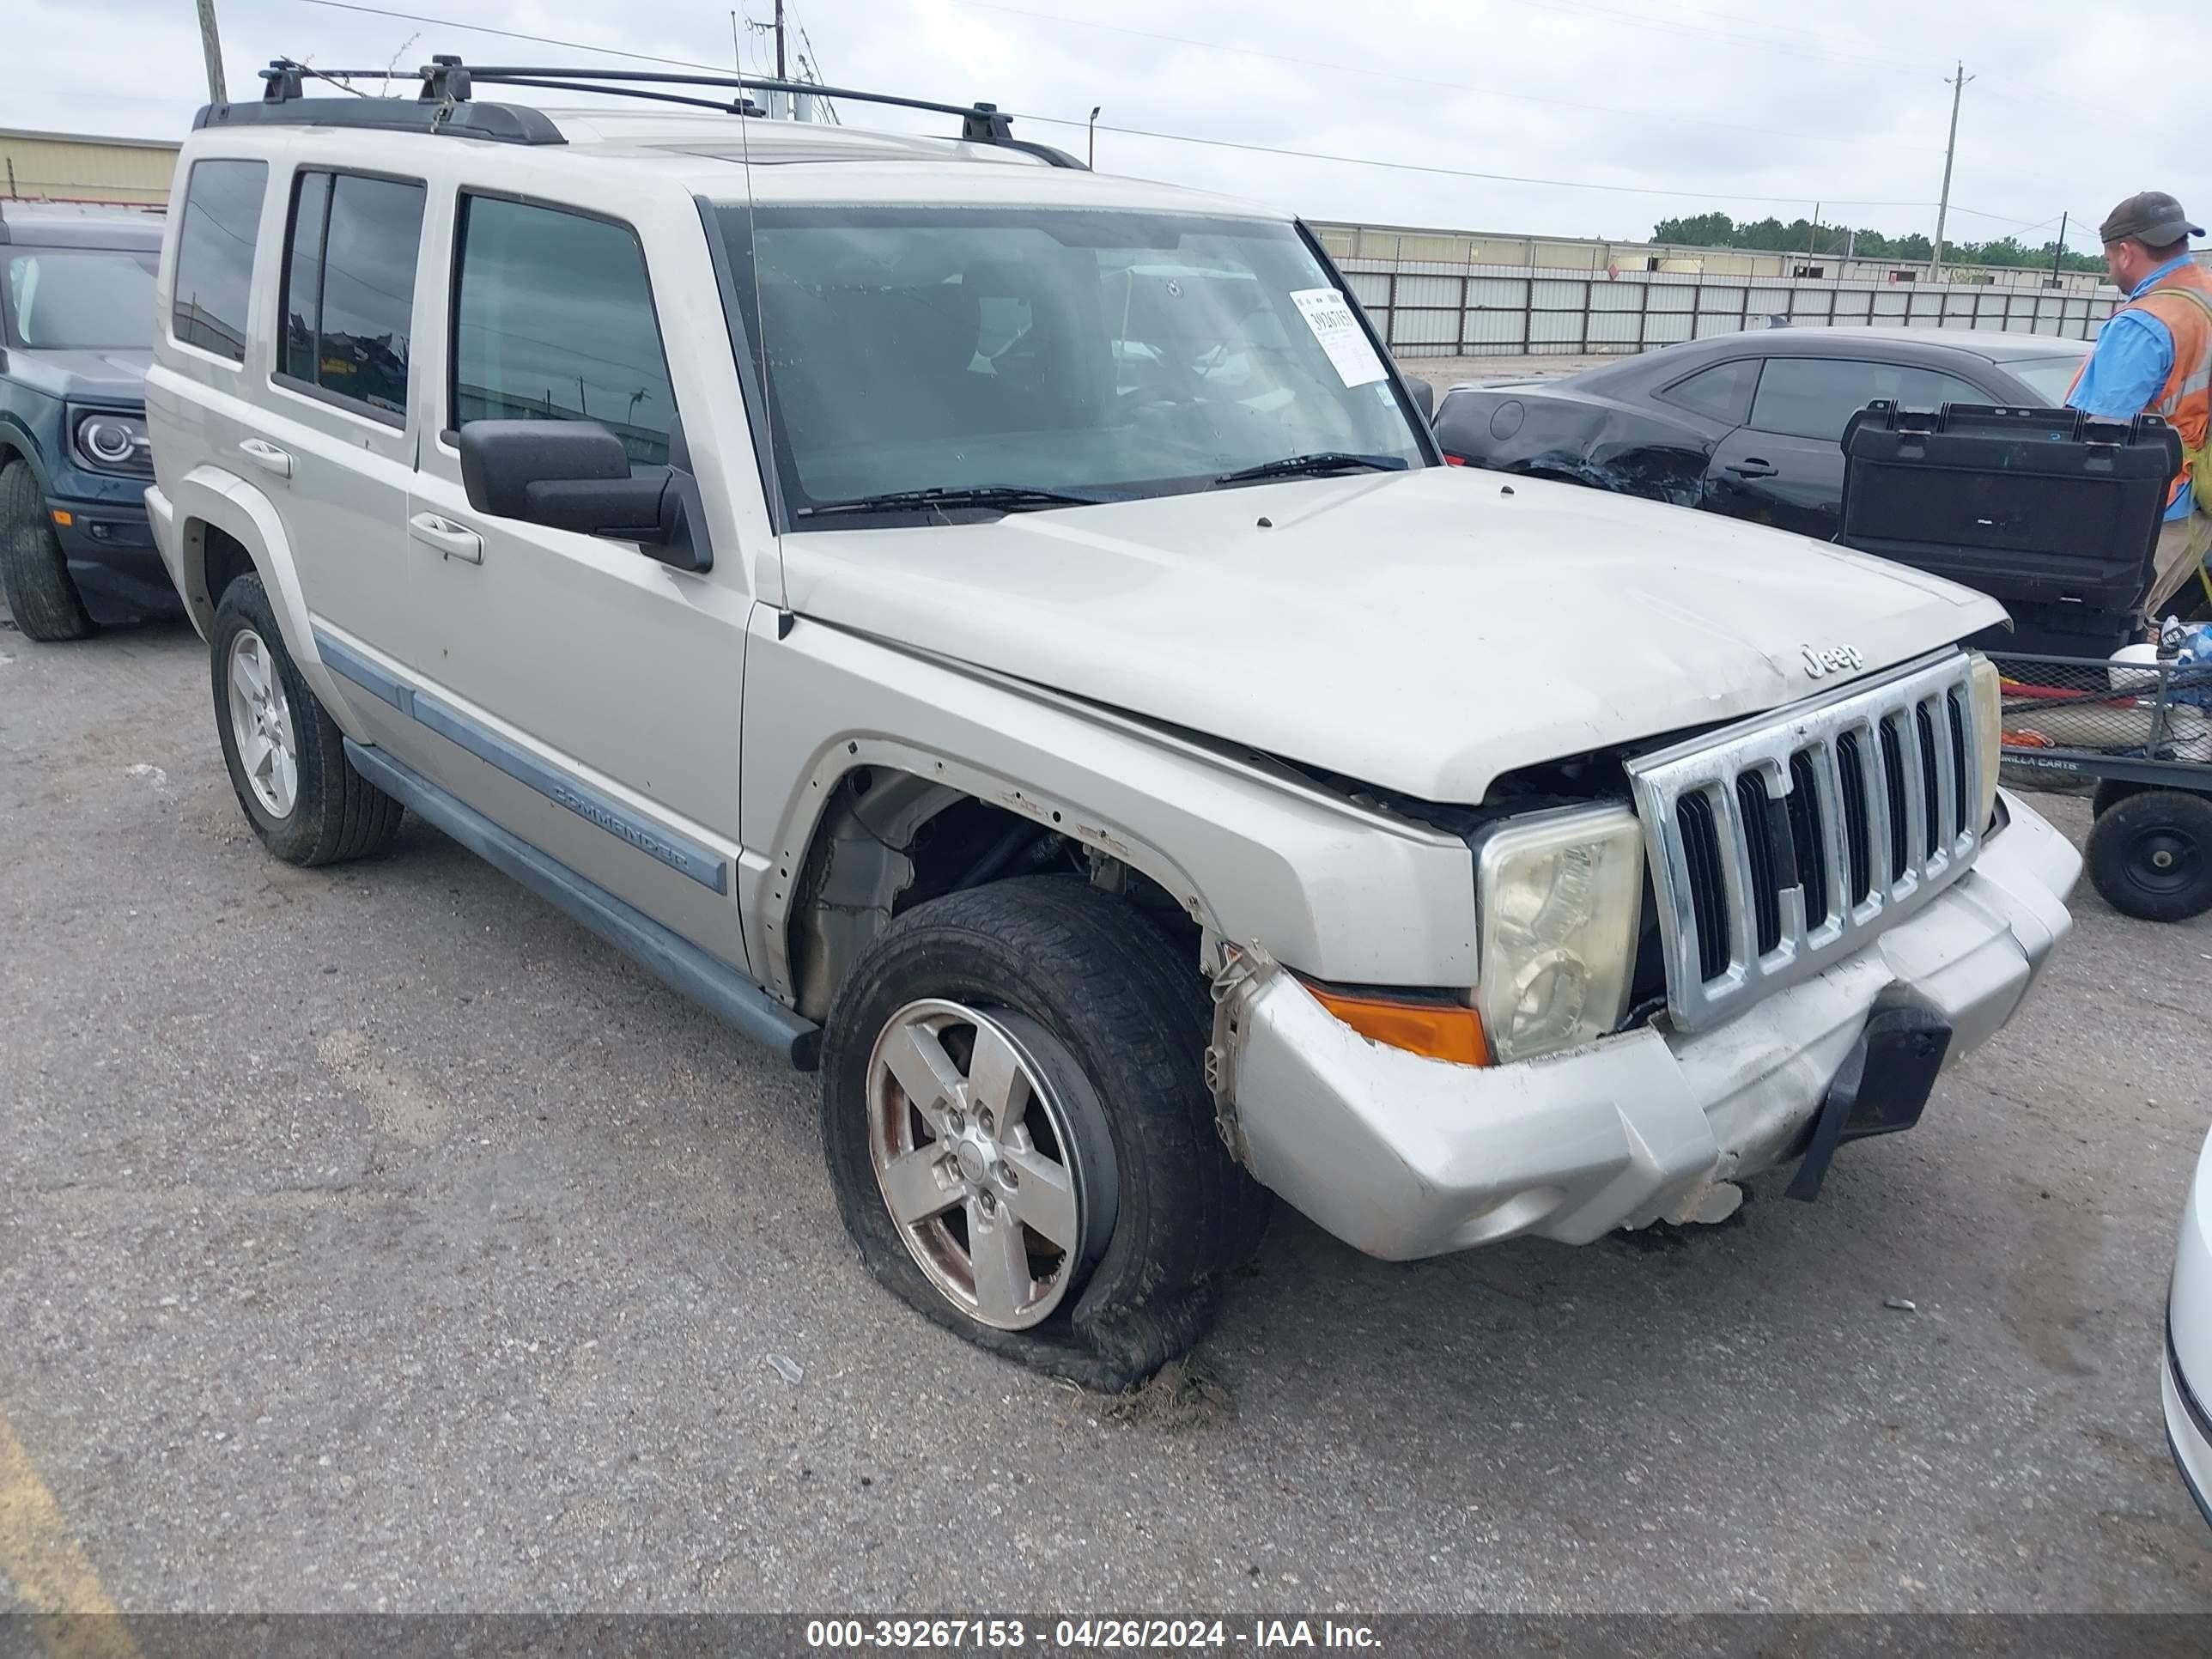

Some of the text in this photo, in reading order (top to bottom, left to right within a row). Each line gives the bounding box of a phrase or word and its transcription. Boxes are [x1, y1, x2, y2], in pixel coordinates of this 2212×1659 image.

[1310, 310, 1354, 331] 39267153
[1801, 643, 1863, 679] Jeep
[2038, 758, 2078, 771] CARTS
